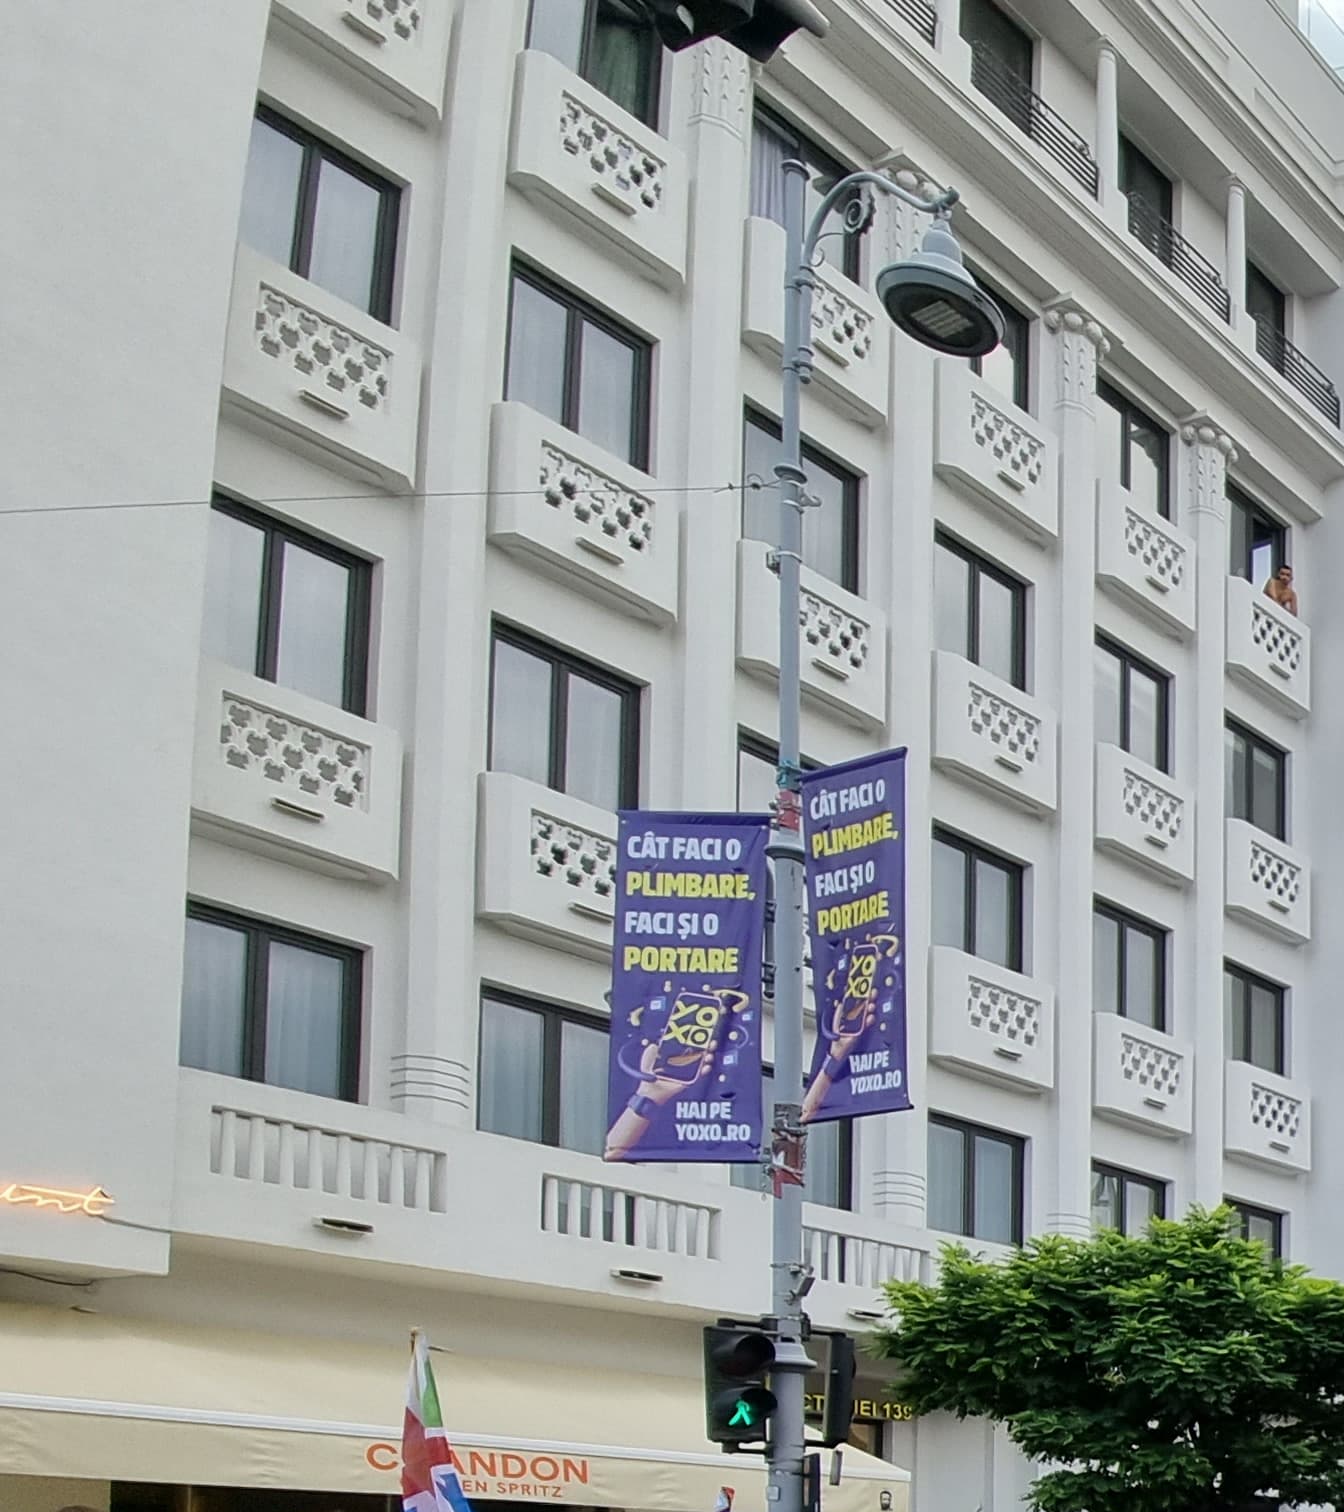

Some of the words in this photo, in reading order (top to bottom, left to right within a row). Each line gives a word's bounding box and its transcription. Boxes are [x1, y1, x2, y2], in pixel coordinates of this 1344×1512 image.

[810, 788, 837, 822] CÂT
[839, 781, 873, 812] FACI
[875, 779, 886, 802] O
[627, 831, 668, 860] CÂT
[672, 838, 722, 861] FACI
[725, 838, 742, 861] O
[811, 812, 900, 860] PLIMBARE,
[625, 870, 757, 901] PLIMBARE,
[815, 868, 848, 898] FACI
[864, 861, 876, 884] O
[624, 911, 673, 935] FACI
[677, 911, 700, 941] ȘI
[703, 912, 720, 935] O
[816, 890, 890, 937] PORTARE
[623, 944, 740, 974] PORTARE
[848, 1053, 871, 1074] HAI
[872, 1050, 890, 1069] PE
[675, 1101, 707, 1120] HAI
[709, 1101, 732, 1120] PE
[675, 1121, 751, 1143] YOXO.RO
[497, 1482, 562, 1498] SPRITZ
